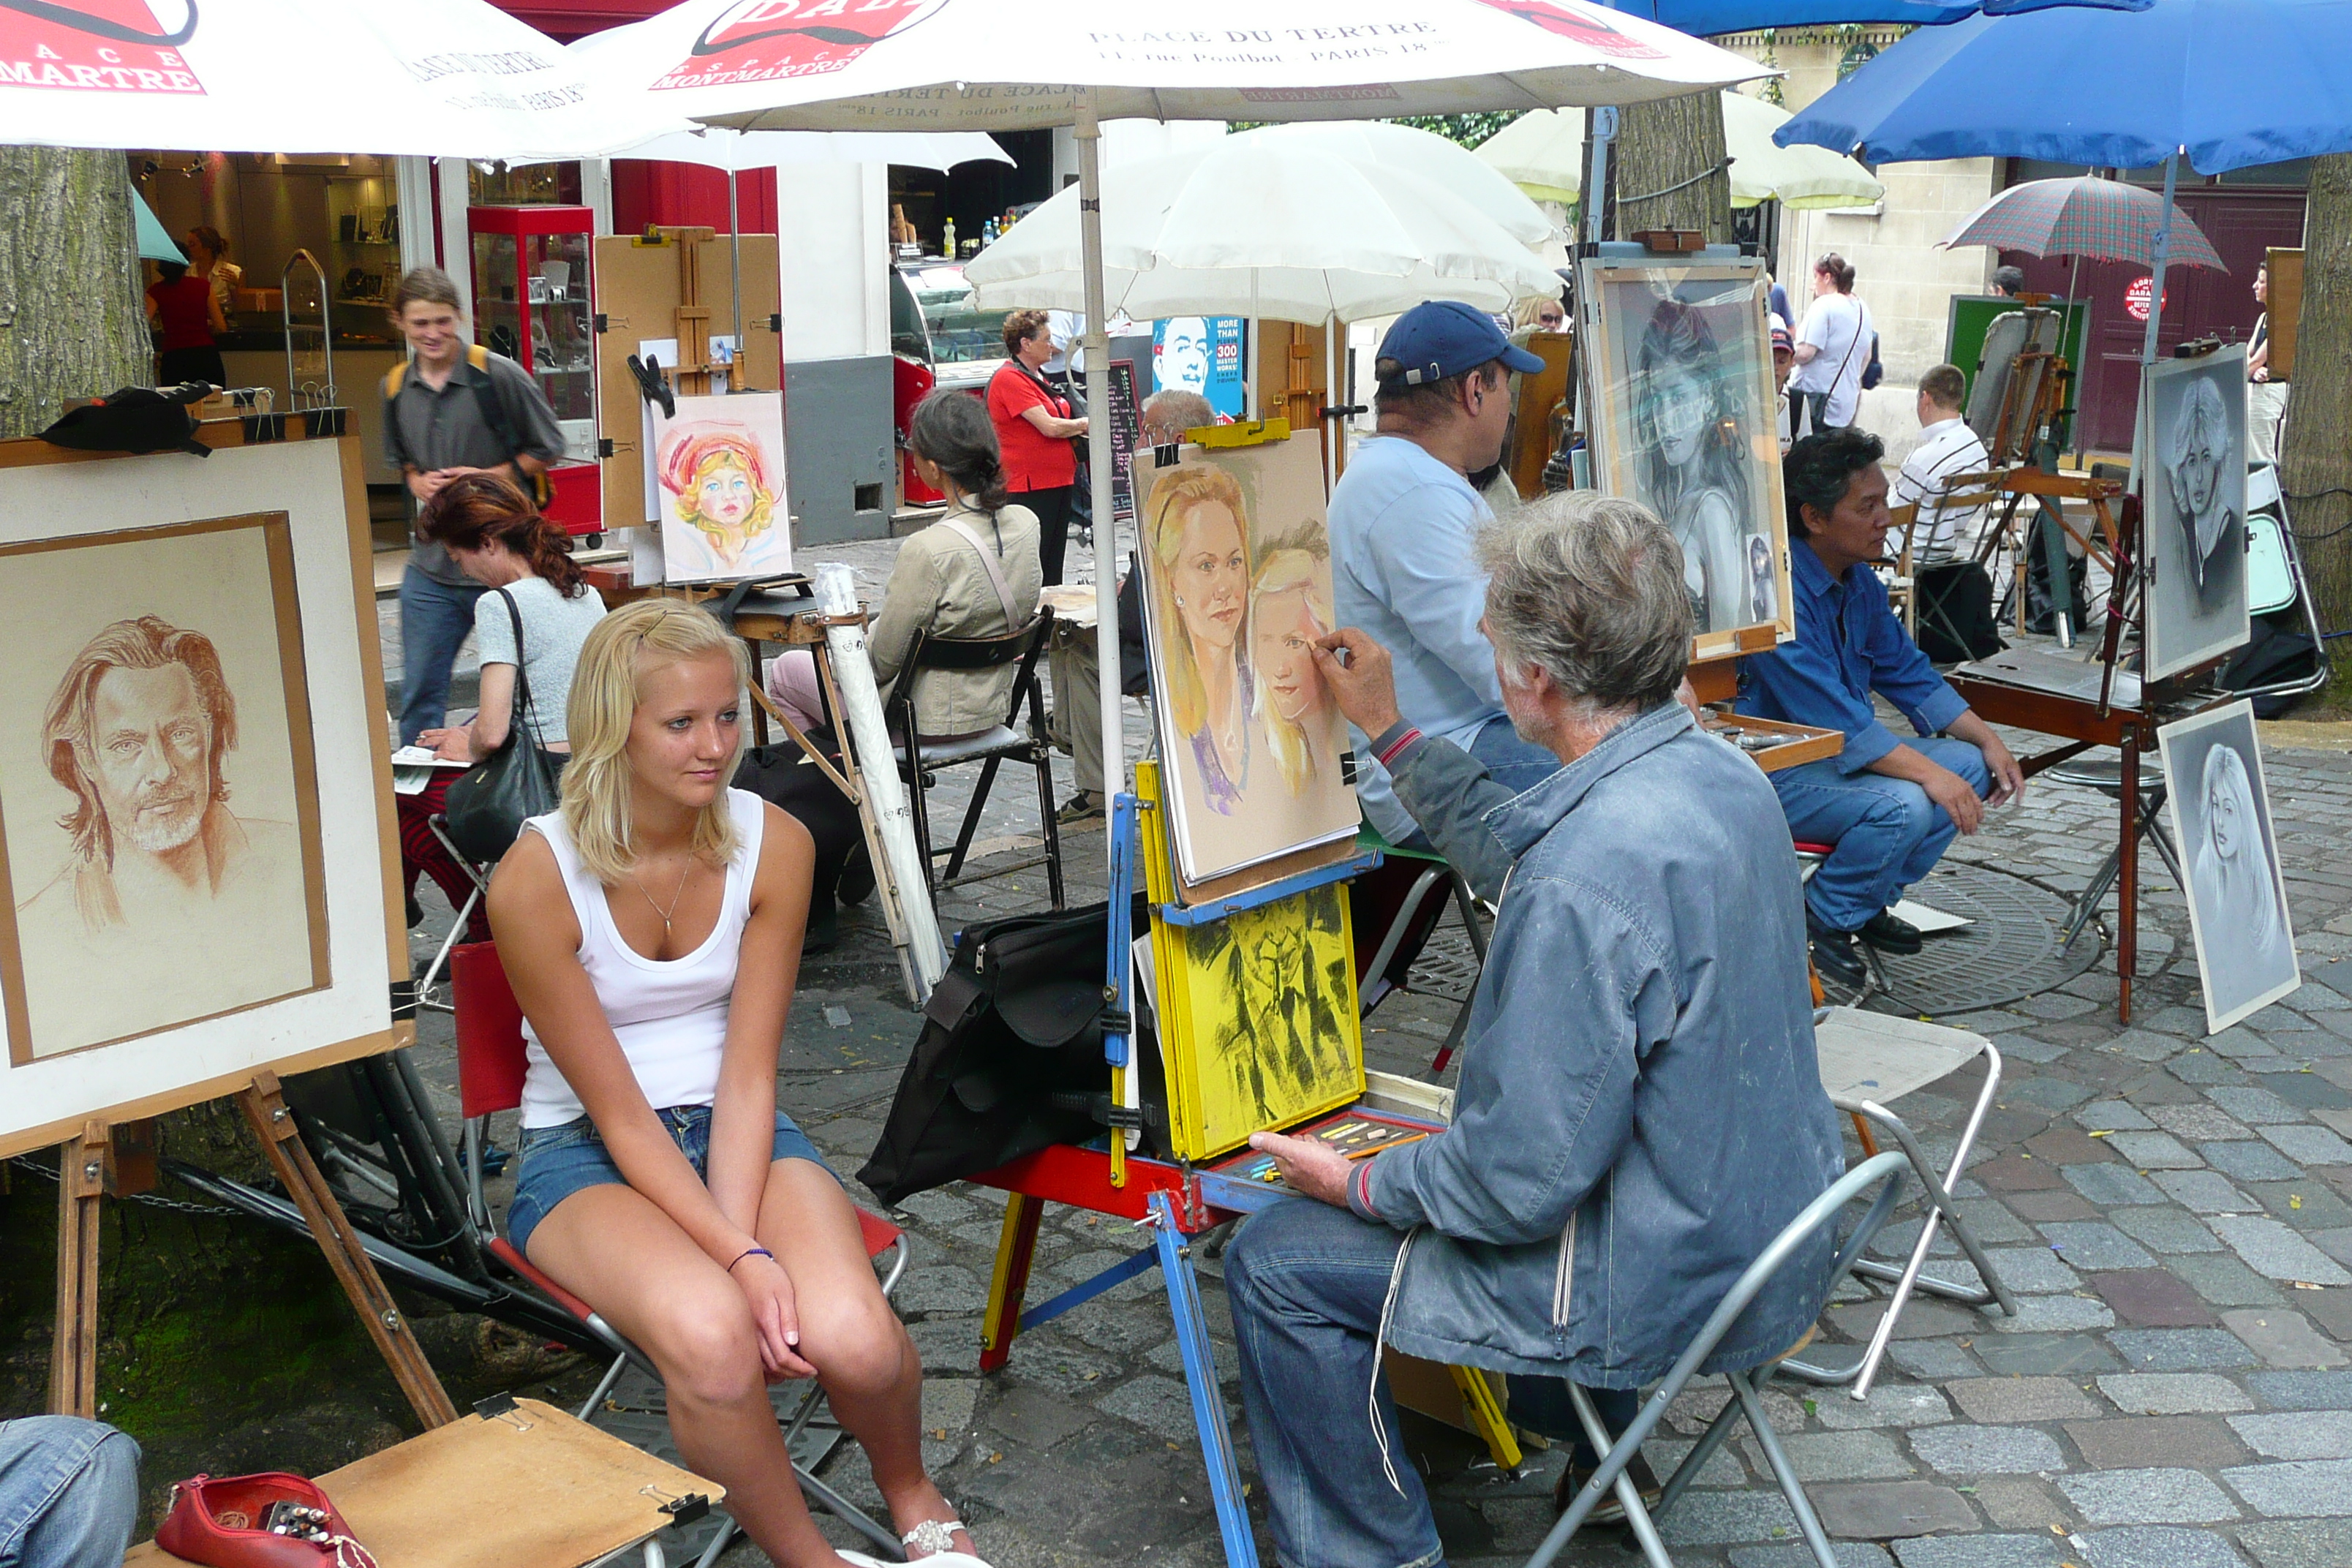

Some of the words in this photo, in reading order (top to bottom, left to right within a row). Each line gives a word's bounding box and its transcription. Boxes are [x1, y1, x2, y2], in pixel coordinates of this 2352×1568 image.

[1089, 31, 1211, 42] PLACE
[1224, 30, 1273, 42] DU
[1286, 22, 1436, 40] TERTRE
[1311, 47, 1388, 61] PARIS
[651, 58, 852, 89] MONTMARTRE
[521, 90, 565, 110] PARIS
[1217, 320, 1238, 328] MORE
[1217, 329, 1238, 338] THAN
[1217, 345, 1237, 358] 300
